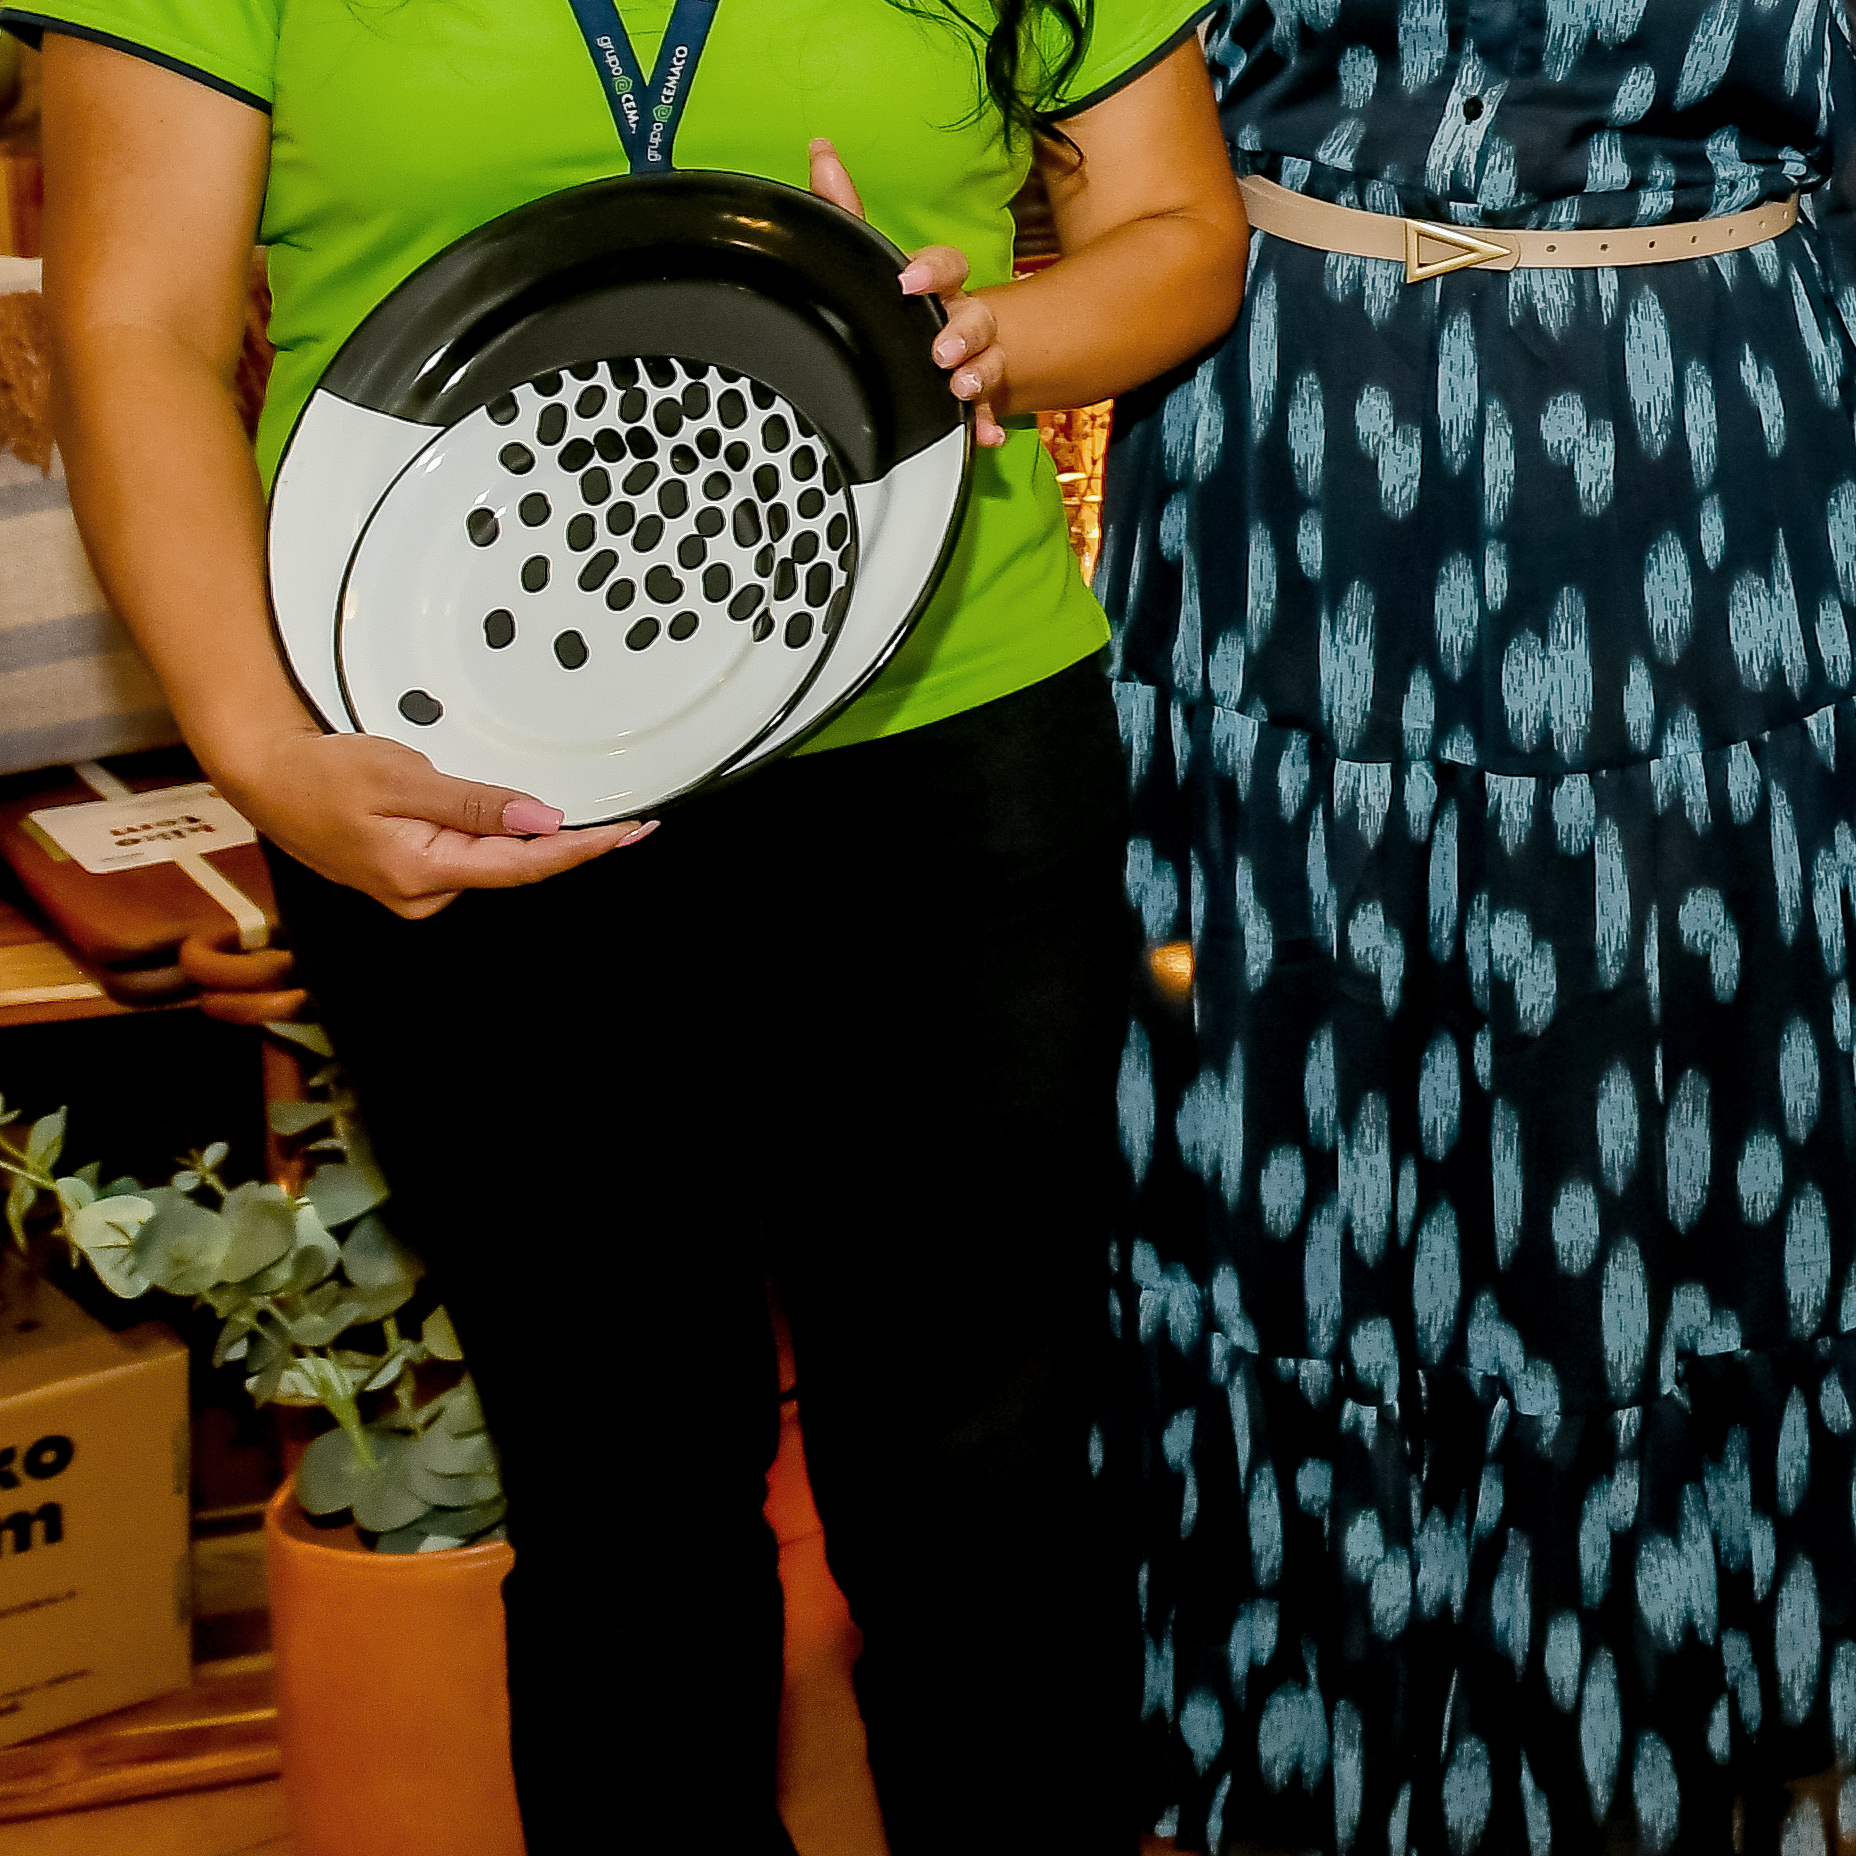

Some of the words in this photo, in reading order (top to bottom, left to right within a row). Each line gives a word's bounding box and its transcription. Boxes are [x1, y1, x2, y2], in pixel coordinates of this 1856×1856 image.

[596, 35, 622, 76] grupo
[647, 122, 663, 162] grupo
[661, 45, 688, 104] CEMACO
